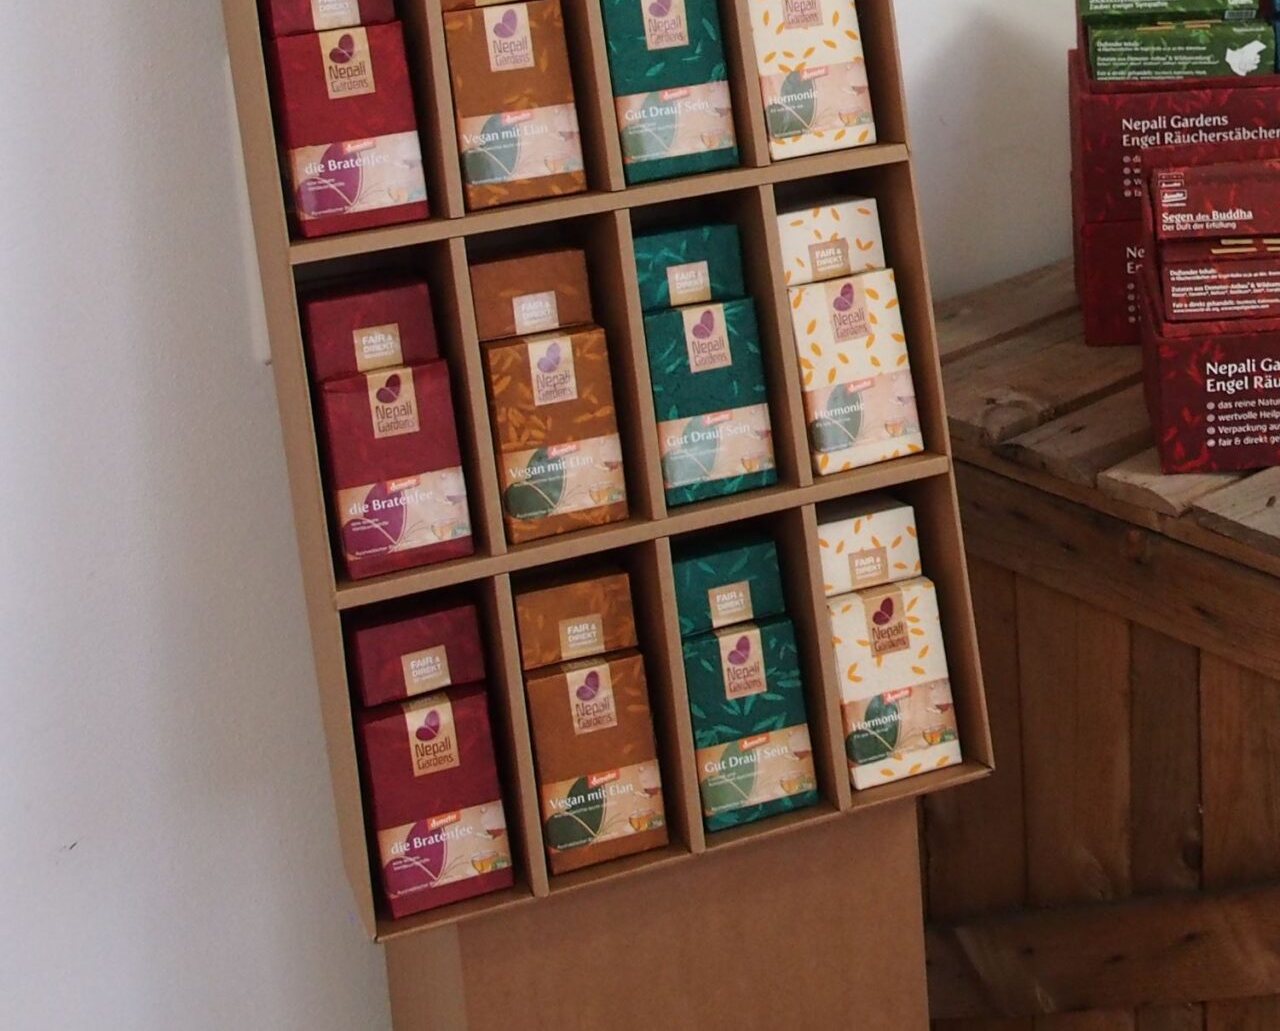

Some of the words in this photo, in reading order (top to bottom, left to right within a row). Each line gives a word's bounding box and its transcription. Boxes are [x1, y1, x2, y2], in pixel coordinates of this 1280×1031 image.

[649, 16, 681, 34] Nepali
[787, 11, 818, 24] Gardens
[493, 37, 527, 55] Nepali
[651, 33, 683, 45] Gardens
[495, 54, 530, 67] Gardens
[329, 61, 365, 80] Nepali
[332, 79, 368, 92] Gardens
[625, 109, 647, 121] Gut
[650, 103, 680, 118] Drauf
[684, 100, 709, 113] Sein
[1122, 117, 1166, 132] Nepali
[1171, 114, 1228, 128] Gardens
[463, 130, 499, 146] Vegan
[502, 125, 521, 139] mit
[1123, 133, 1160, 149] Engel
[305, 160, 325, 174] die
[1162, 212, 1193, 222] Segen
[1212, 208, 1253, 219] Buddha
[1162, 223, 1175, 231] Der
[1176, 222, 1191, 230] Duft
[1206, 221, 1236, 229] Erfüllung
[833, 308, 864, 326] Nepali
[836, 324, 867, 338] Gardens
[692, 338, 725, 355] Nepali
[694, 354, 727, 366] Gardens
[1207, 359, 1256, 377] Nepali
[536, 372, 570, 390] Nepali
[1207, 376, 1248, 394] Engel
[538, 388, 571, 402] Gardens
[1218, 401, 1233, 409] das
[1235, 399, 1256, 408] reine
[376, 403, 412, 421] Nepali
[1218, 412, 1257, 422] wertvolle
[378, 420, 414, 433] Gardens
[1219, 424, 1267, 435] Verpackung
[667, 432, 688, 447] Gut
[691, 427, 722, 443] Drauf
[726, 424, 750, 436] Sein
[1219, 438, 1232, 447] fair
[1234, 437, 1241, 445] &
[1243, 434, 1268, 444] direkt
[509, 463, 544, 479] Vegan
[547, 458, 566, 472] mit
[349, 500, 370, 515] die
[567, 624, 588, 635] FAIR
[568, 632, 597, 642] DIREKT
[872, 624, 904, 642] Nepali
[874, 638, 906, 652] Gardens
[410, 657, 433, 669] FAIR
[412, 663, 441, 676] DIREKT
[727, 662, 759, 683] Nepali
[729, 679, 762, 693] Gardens
[576, 697, 610, 717] Nepali
[578, 715, 612, 729] Gardens
[415, 737, 451, 759] Nepali
[417, 755, 453, 770] Gardens
[705, 759, 727, 773] Gut
[730, 752, 762, 769] Drauf
[765, 745, 788, 758] Sein
[550, 794, 585, 811] Vegan
[587, 787, 607, 802] mit
[610, 782, 633, 795] Elan
[391, 839, 410, 854] die
[414, 825, 473, 849] Bratenfee
